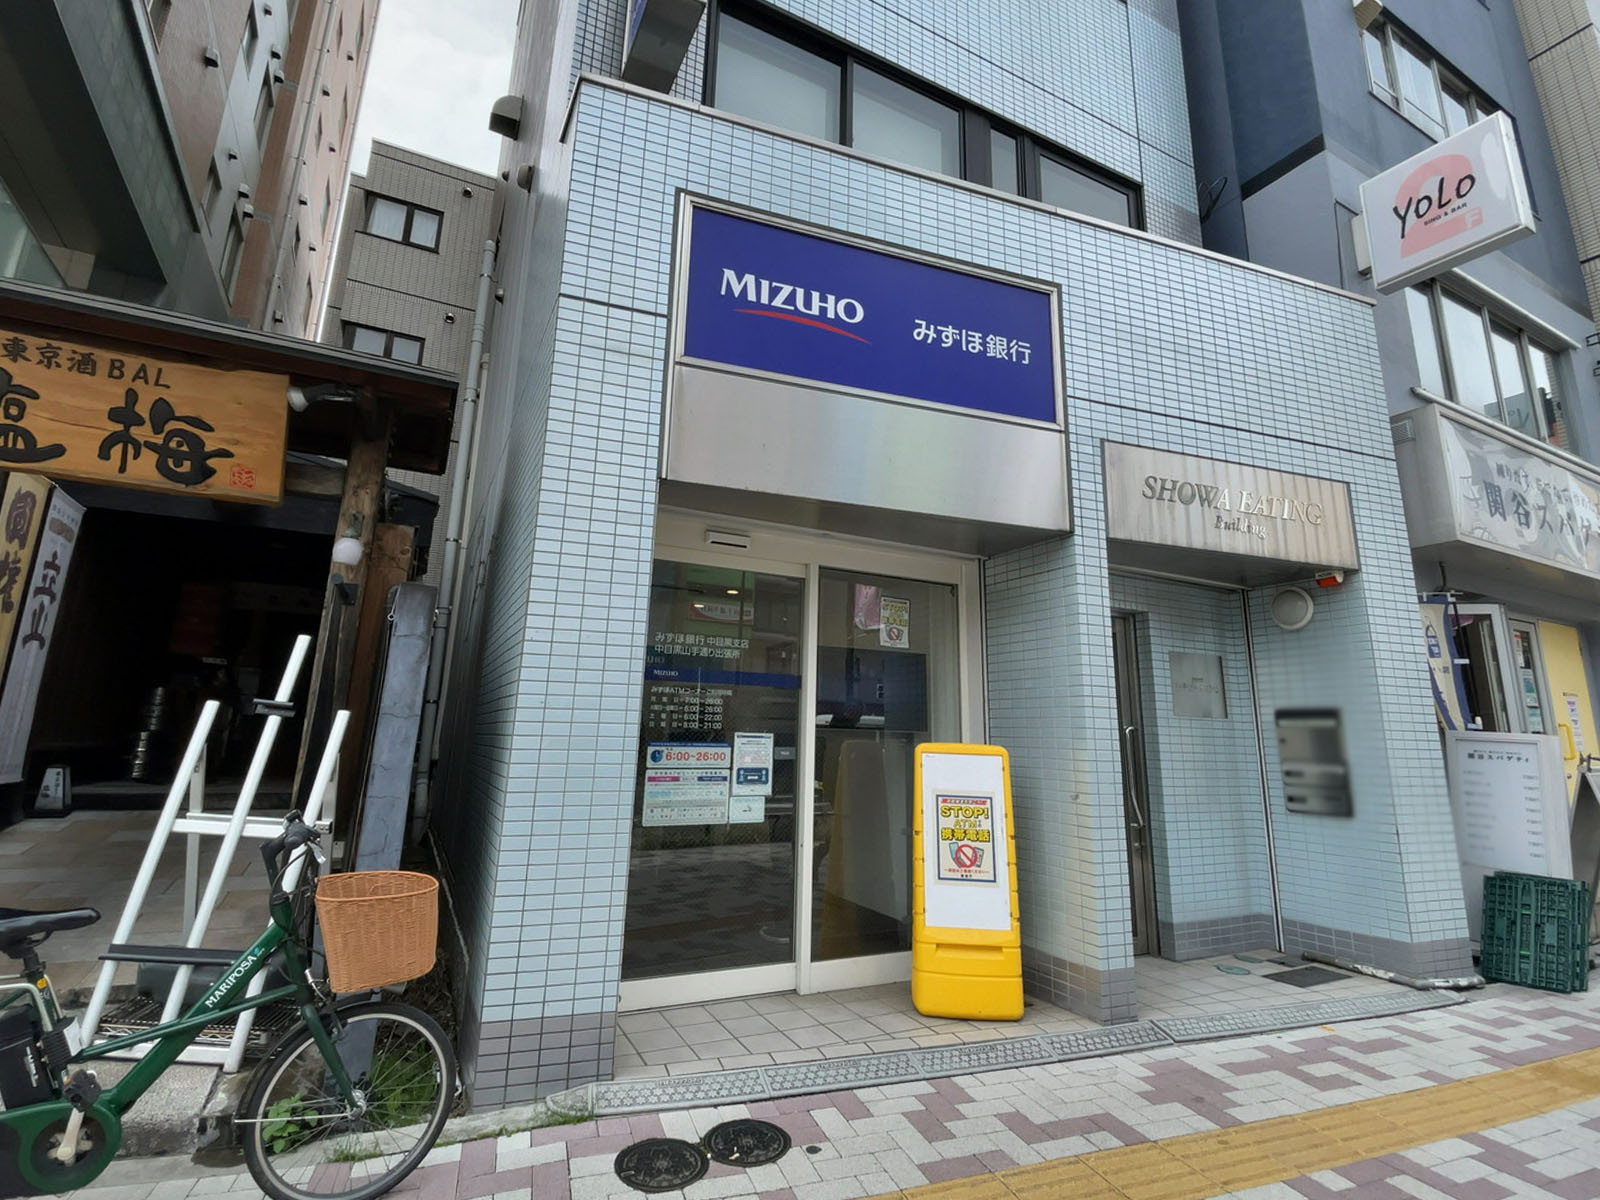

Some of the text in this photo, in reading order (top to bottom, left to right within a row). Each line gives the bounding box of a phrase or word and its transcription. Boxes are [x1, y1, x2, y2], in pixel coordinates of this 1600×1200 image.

[1392, 173, 1476, 240] YOLO
[1450, 202, 1468, 214] BAR
[721, 268, 864, 324] MIZUHO
[913, 318, 1032, 366] みずほ銀行
[1142, 475, 1322, 525] SHOWA EATING
[1214, 515, 1267, 540] Building
[655, 632, 705, 645] みずほ銀行
[941, 805, 989, 819] STOP!
[941, 827, 991, 843] 携帯電話
[204, 955, 258, 1008] MARIPOSA
